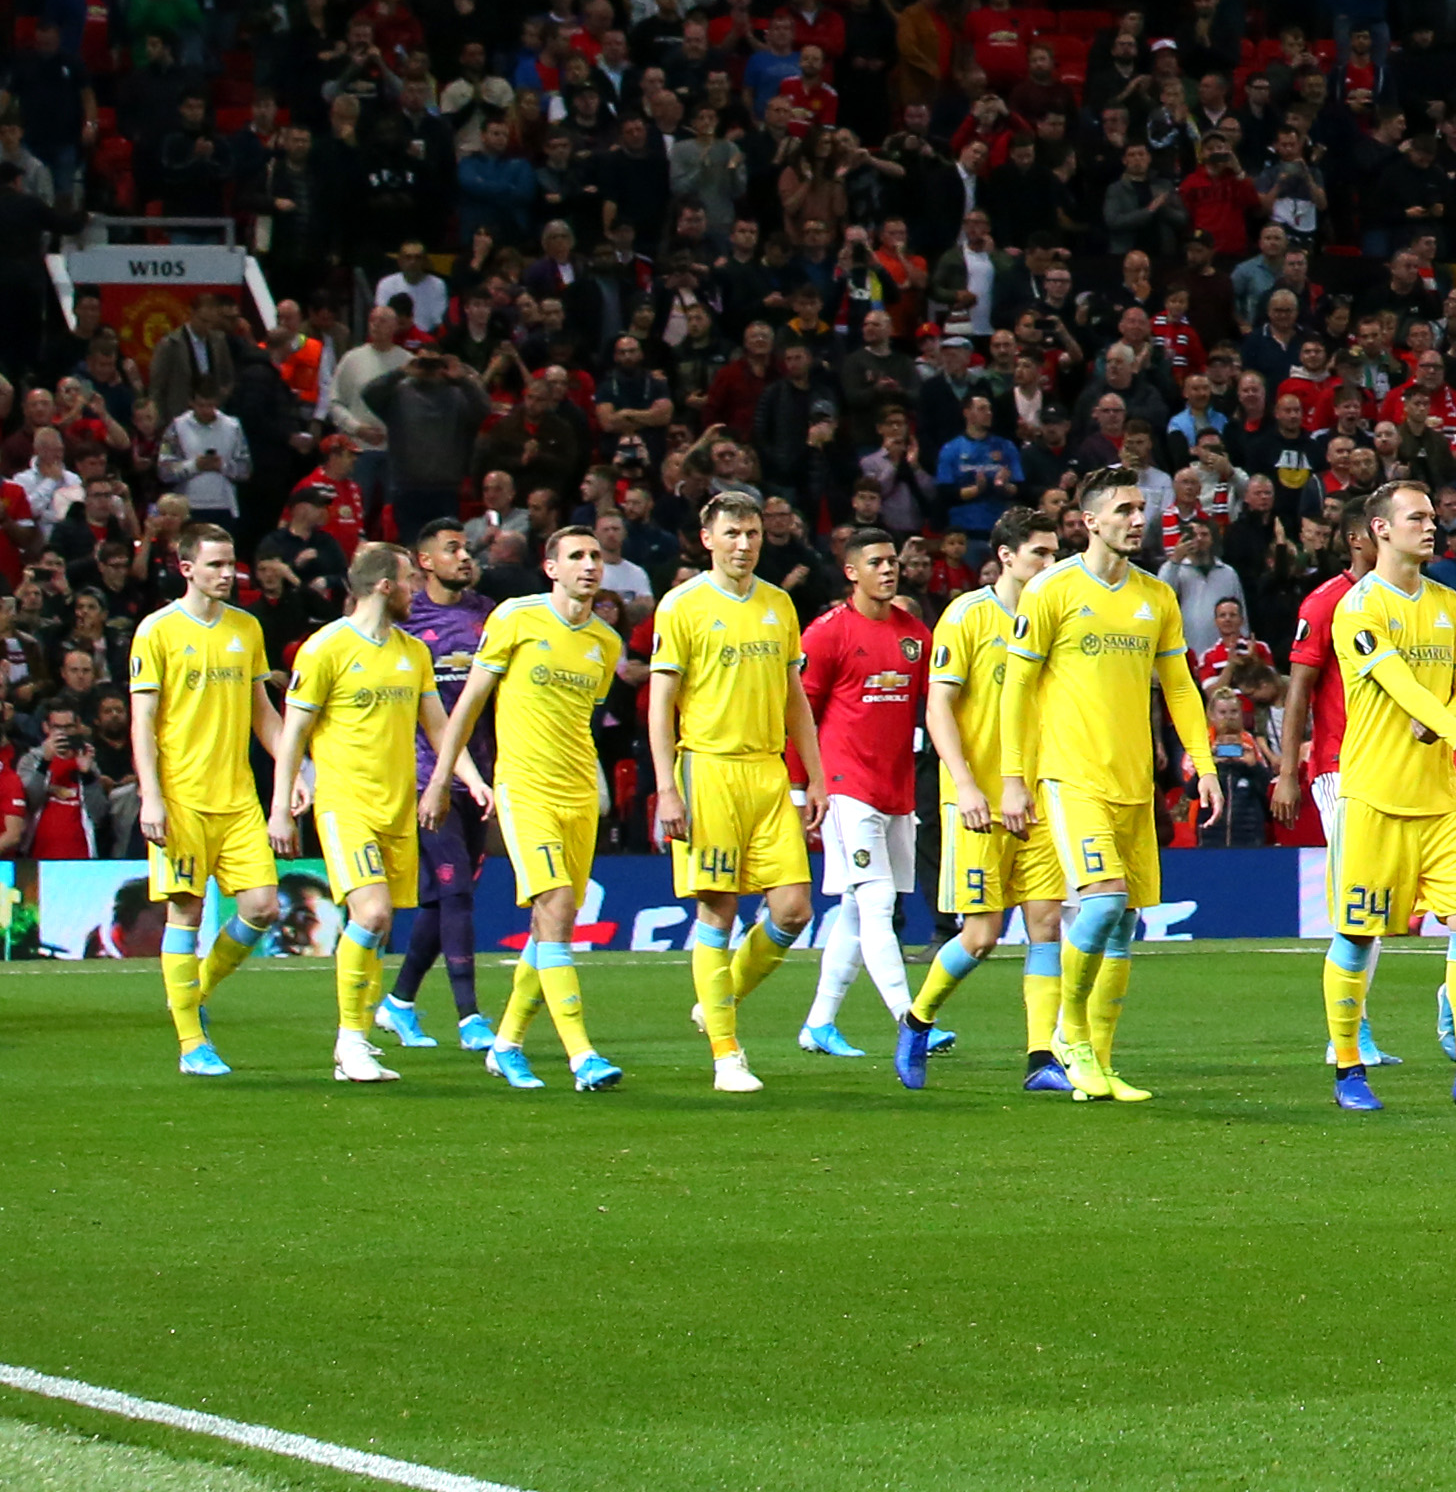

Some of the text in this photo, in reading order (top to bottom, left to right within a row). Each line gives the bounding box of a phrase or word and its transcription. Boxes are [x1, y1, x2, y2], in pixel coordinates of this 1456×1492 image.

[128, 259, 186, 277] W105
[1102, 634, 1150, 650] SAMRUK
[1408, 646, 1454, 660] SAMRUK
[354, 844, 386, 878] 10
[700, 847, 737, 884] 44
[1082, 837, 1104, 873] 6
[966, 868, 984, 905] 9
[1346, 885, 1391, 927] 24
